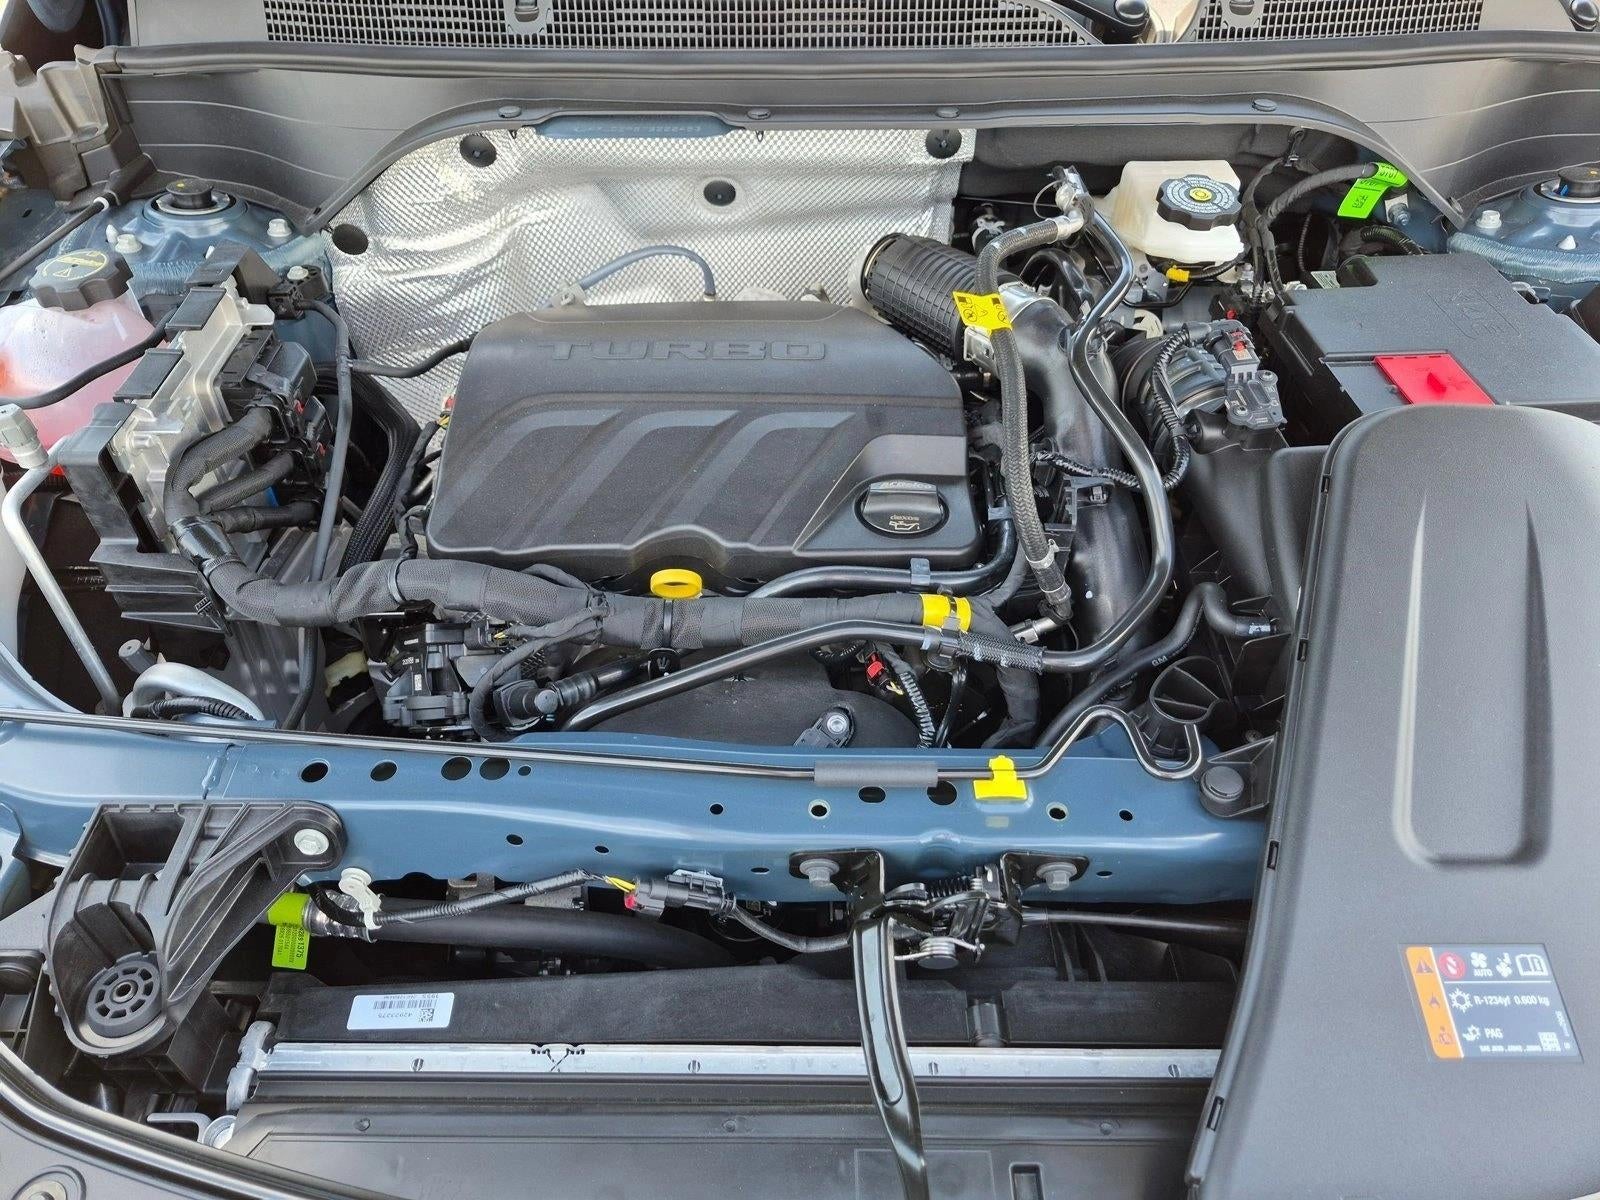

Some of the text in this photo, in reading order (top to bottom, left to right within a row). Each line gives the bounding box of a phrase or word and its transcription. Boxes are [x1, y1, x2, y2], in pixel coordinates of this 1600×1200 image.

[537, 341, 826, 360] TURBO
[1151, 655, 1168, 667] GM
[1473, 968, 1494, 977] AUTO
[1474, 995, 1511, 1007] R-1234yf
[1538, 995, 1550, 1007] kg
[1484, 1028, 1504, 1039] PAG
